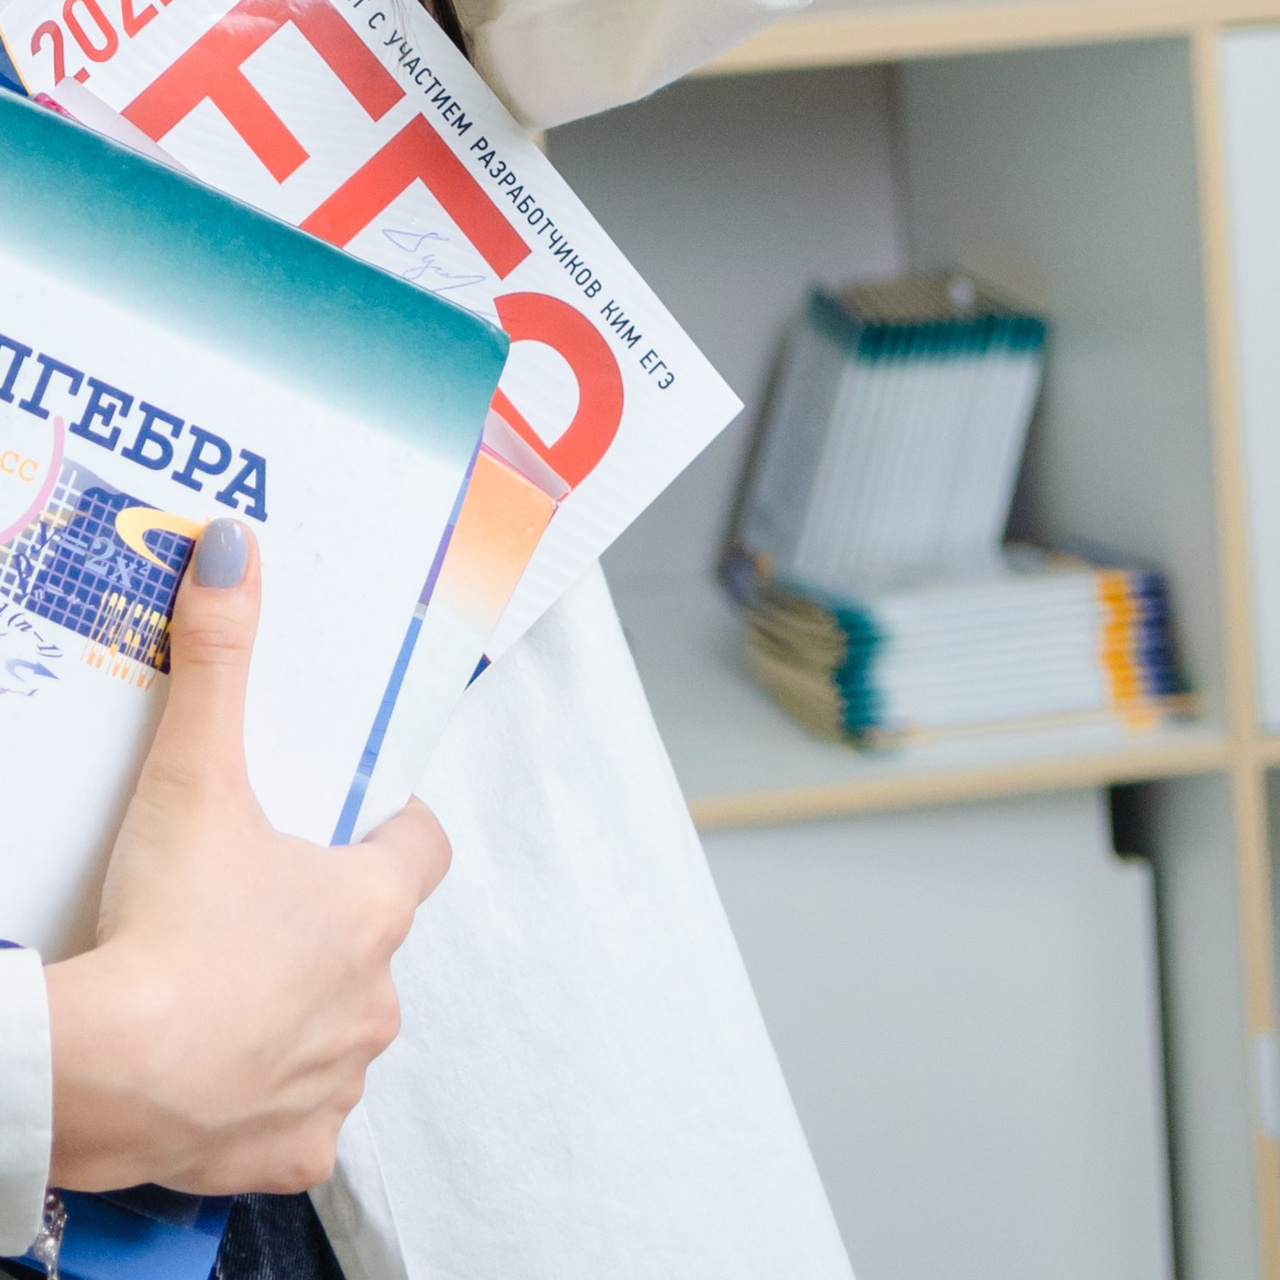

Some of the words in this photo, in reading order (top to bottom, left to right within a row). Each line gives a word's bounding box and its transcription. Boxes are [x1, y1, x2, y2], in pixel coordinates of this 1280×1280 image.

[384, 29, 473, 138] УЧАСТИЕМ
[469, 135, 604, 300] РАЗРАБОТЧИКОВ
[599, 298, 644, 350] КИМ
[638, 349, 676, 391] ЕГЭ
